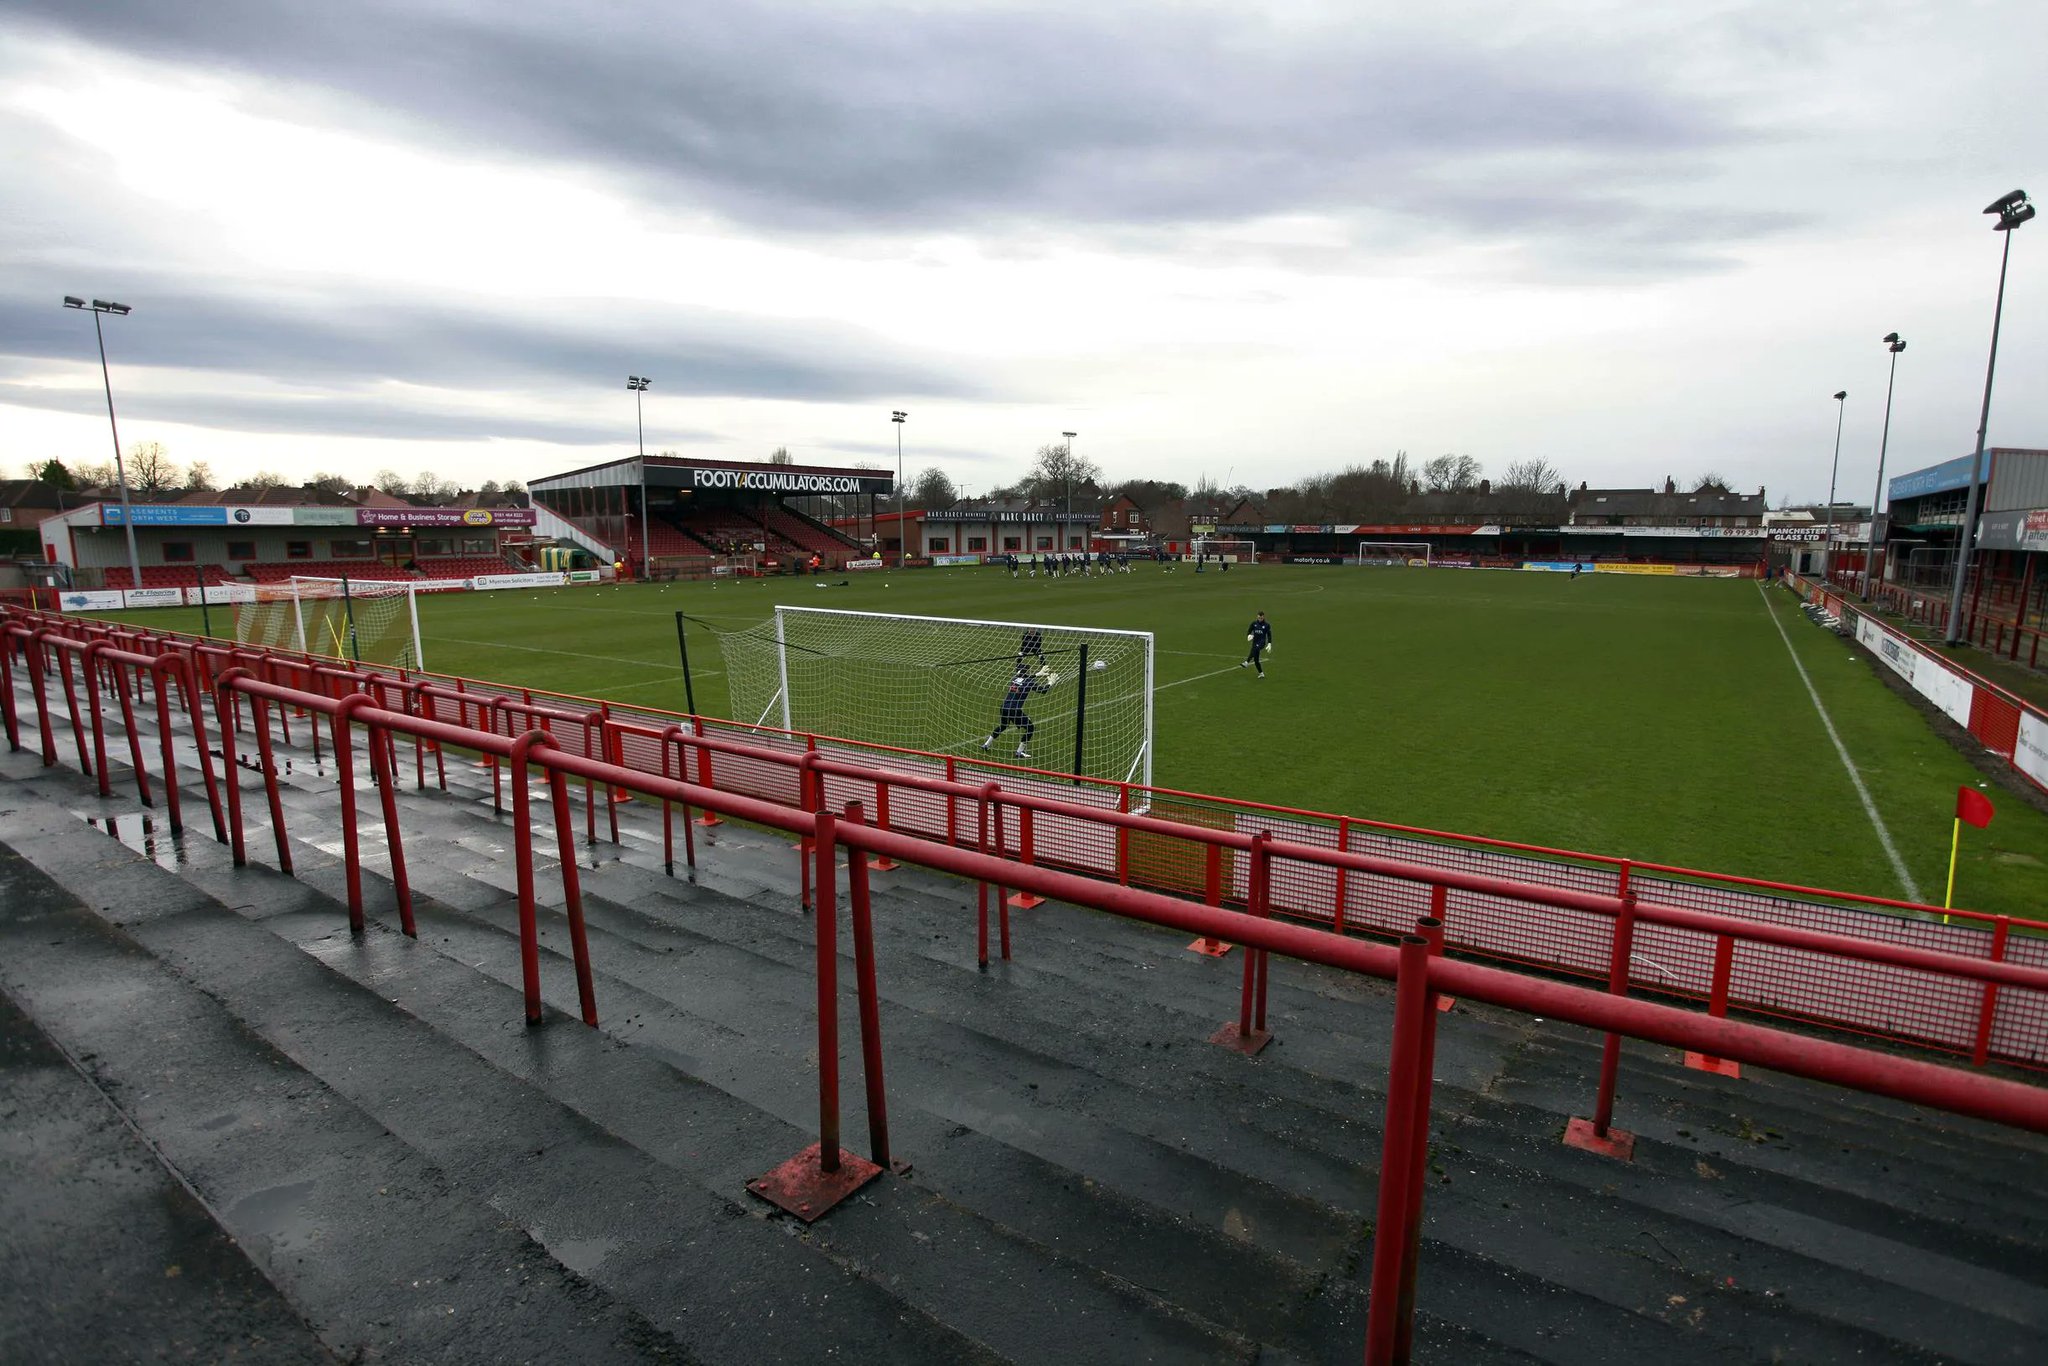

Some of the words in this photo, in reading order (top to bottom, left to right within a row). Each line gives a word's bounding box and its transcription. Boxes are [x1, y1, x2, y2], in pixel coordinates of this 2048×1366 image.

[378, 513, 399, 521] Home
[400, 513, 406, 521] &
[408, 513, 436, 521] Business
[437, 513, 462, 522] Storage
[1000, 512, 1019, 522] MARC
[1022, 512, 1044, 522] DARCY
